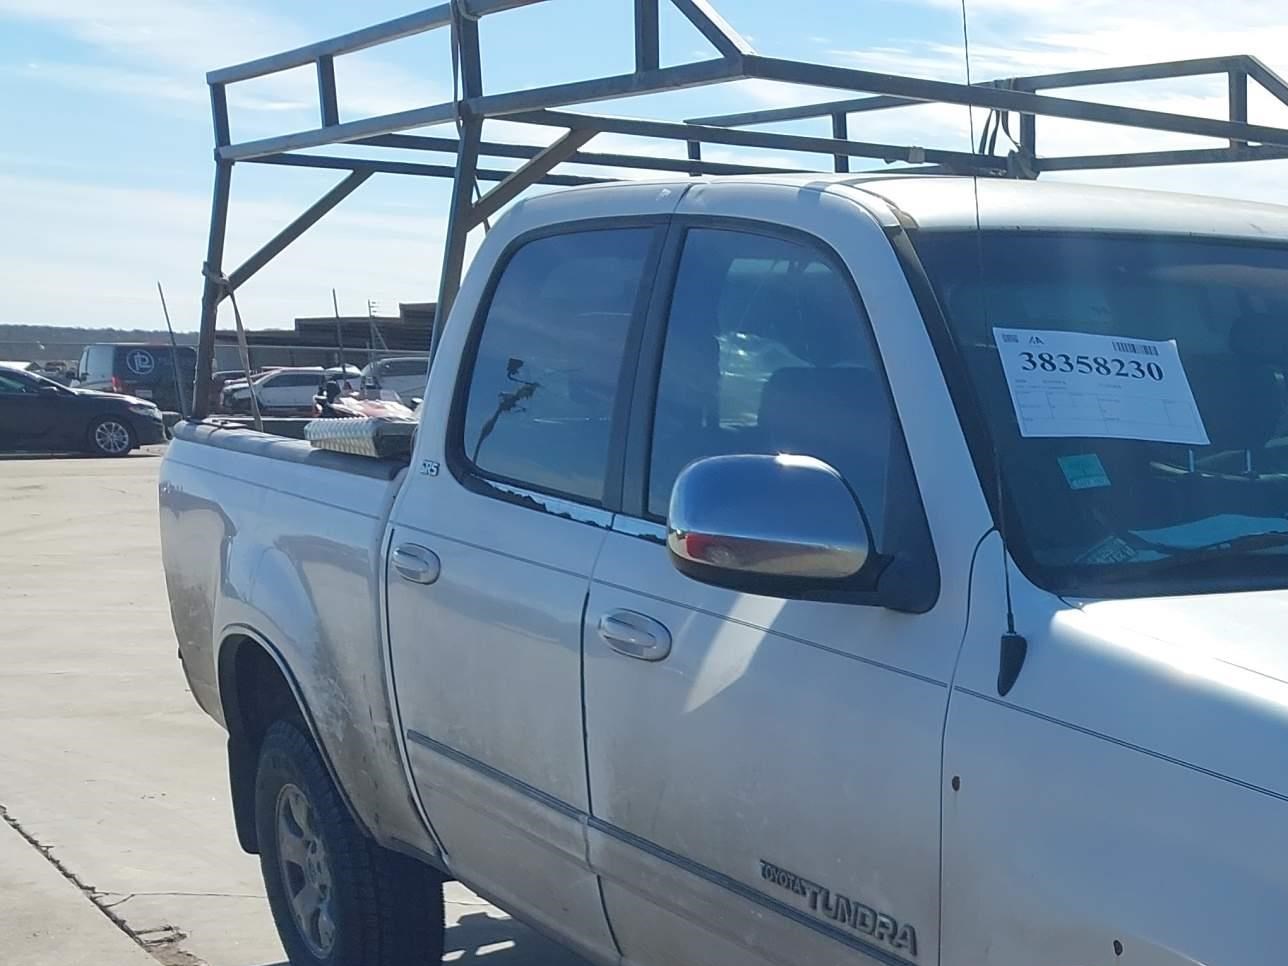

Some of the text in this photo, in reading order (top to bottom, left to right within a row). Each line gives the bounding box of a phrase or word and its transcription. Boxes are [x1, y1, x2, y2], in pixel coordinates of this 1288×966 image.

[1019, 351, 1164, 381] 38358230
[759, 859, 918, 957] TOYOTA TUNDRA
